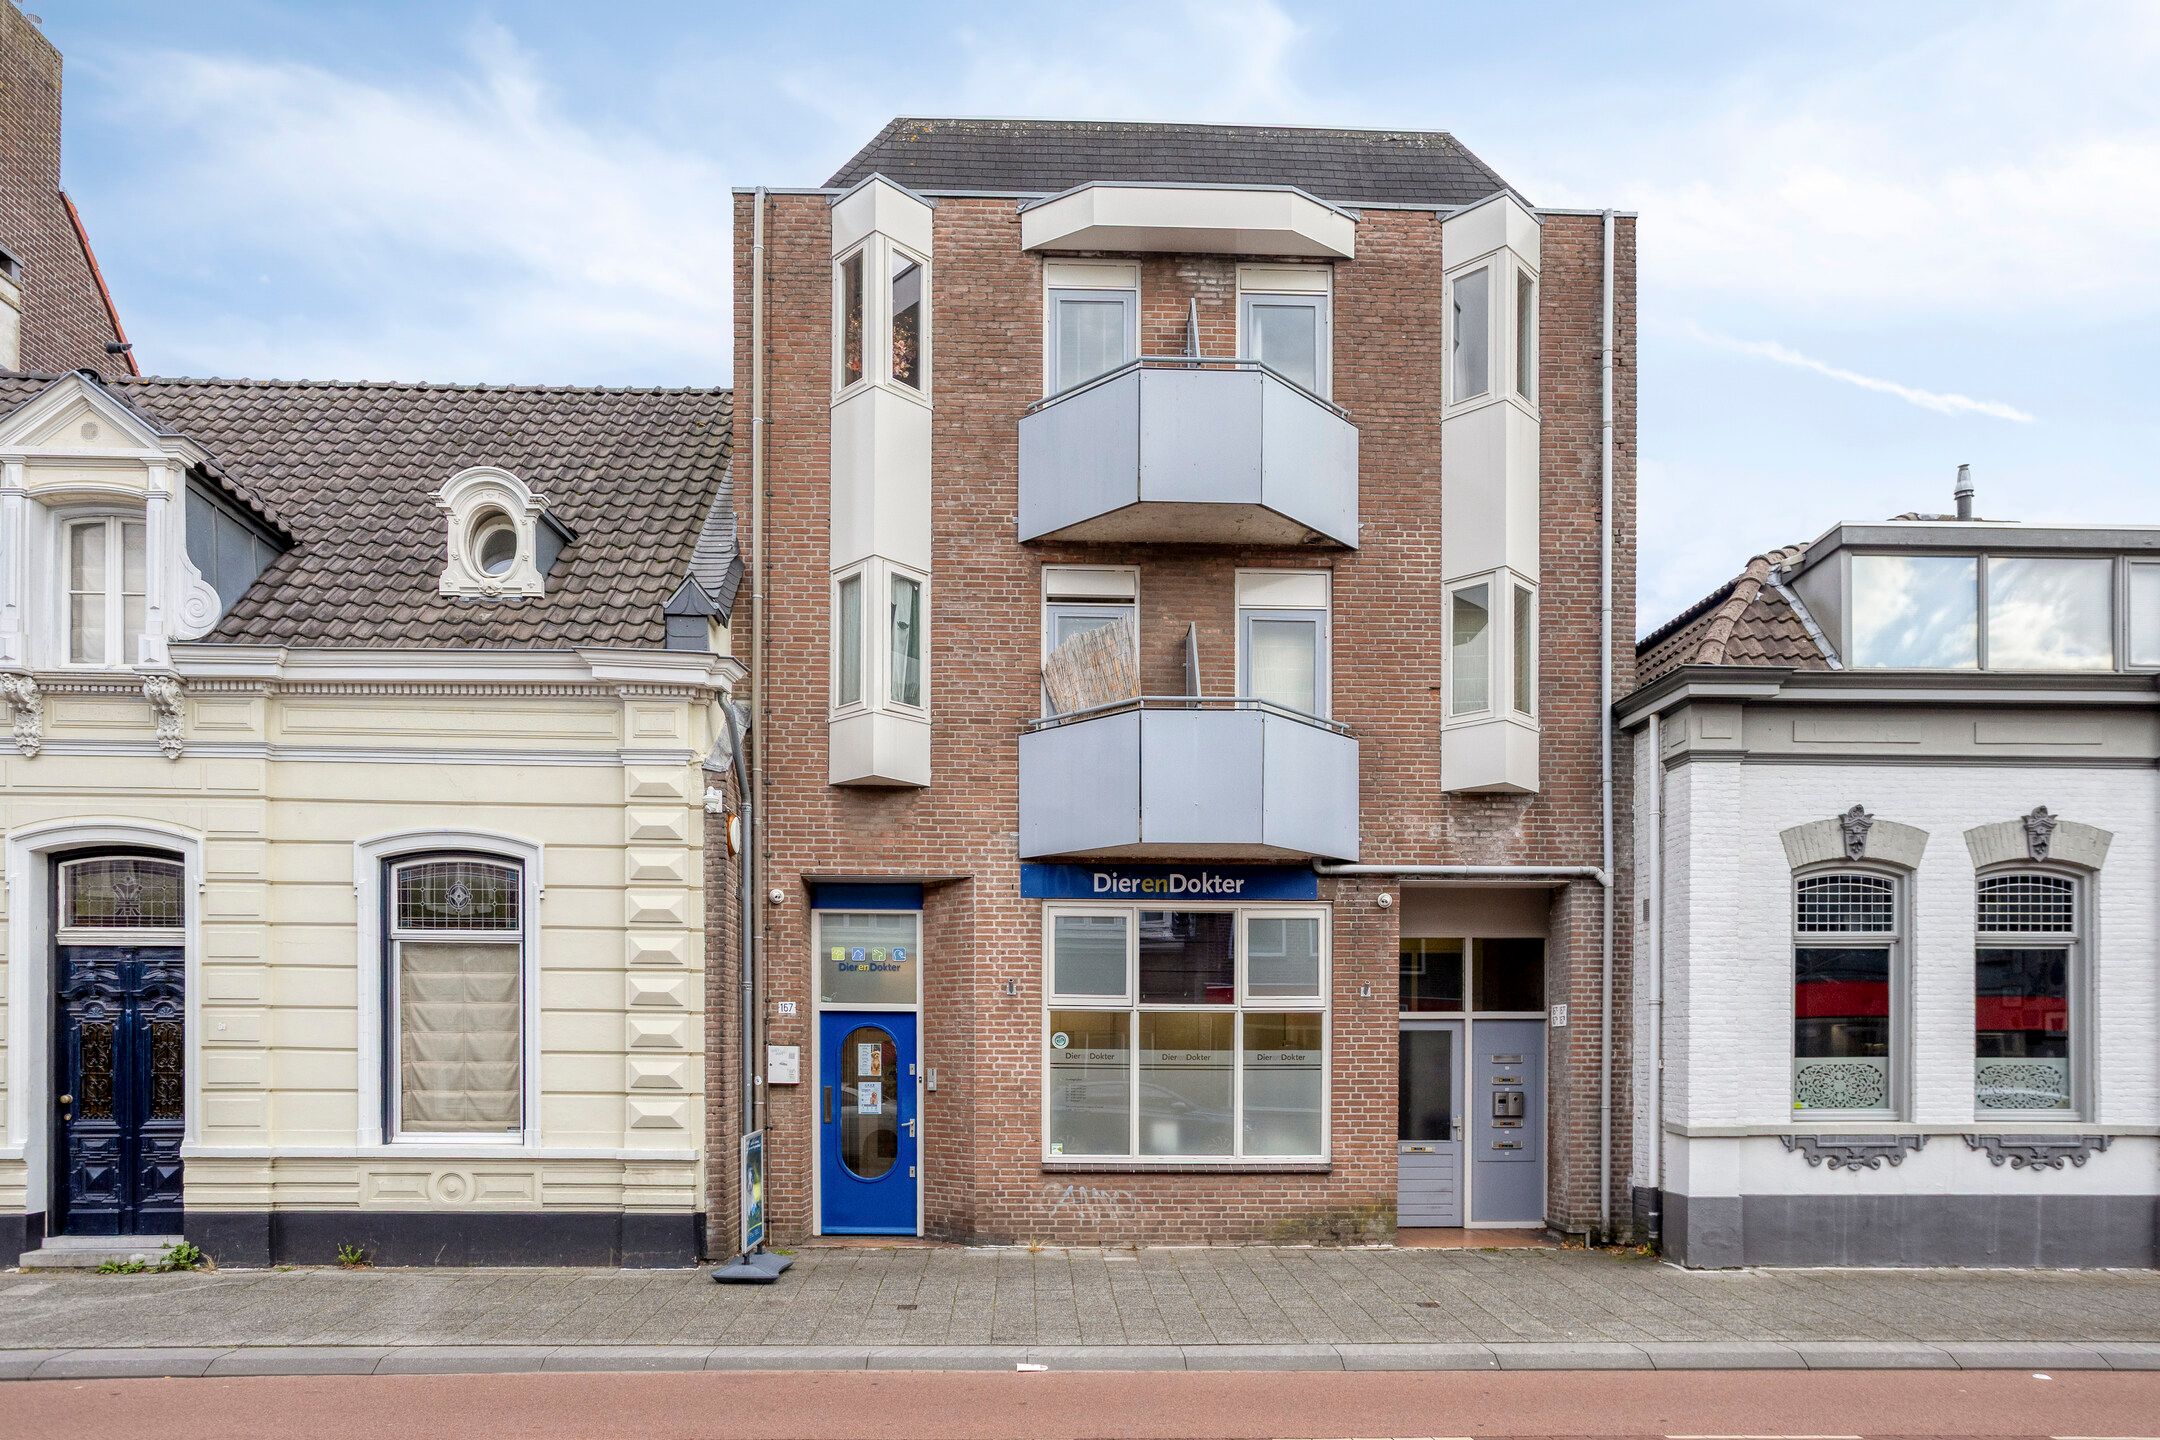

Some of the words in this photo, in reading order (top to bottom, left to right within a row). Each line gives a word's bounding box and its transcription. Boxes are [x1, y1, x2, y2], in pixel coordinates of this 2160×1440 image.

[1093, 872, 1245, 893] DierenDokter
[838, 963, 901, 972] DierenDokter
[780, 1003, 794, 1012] 167
